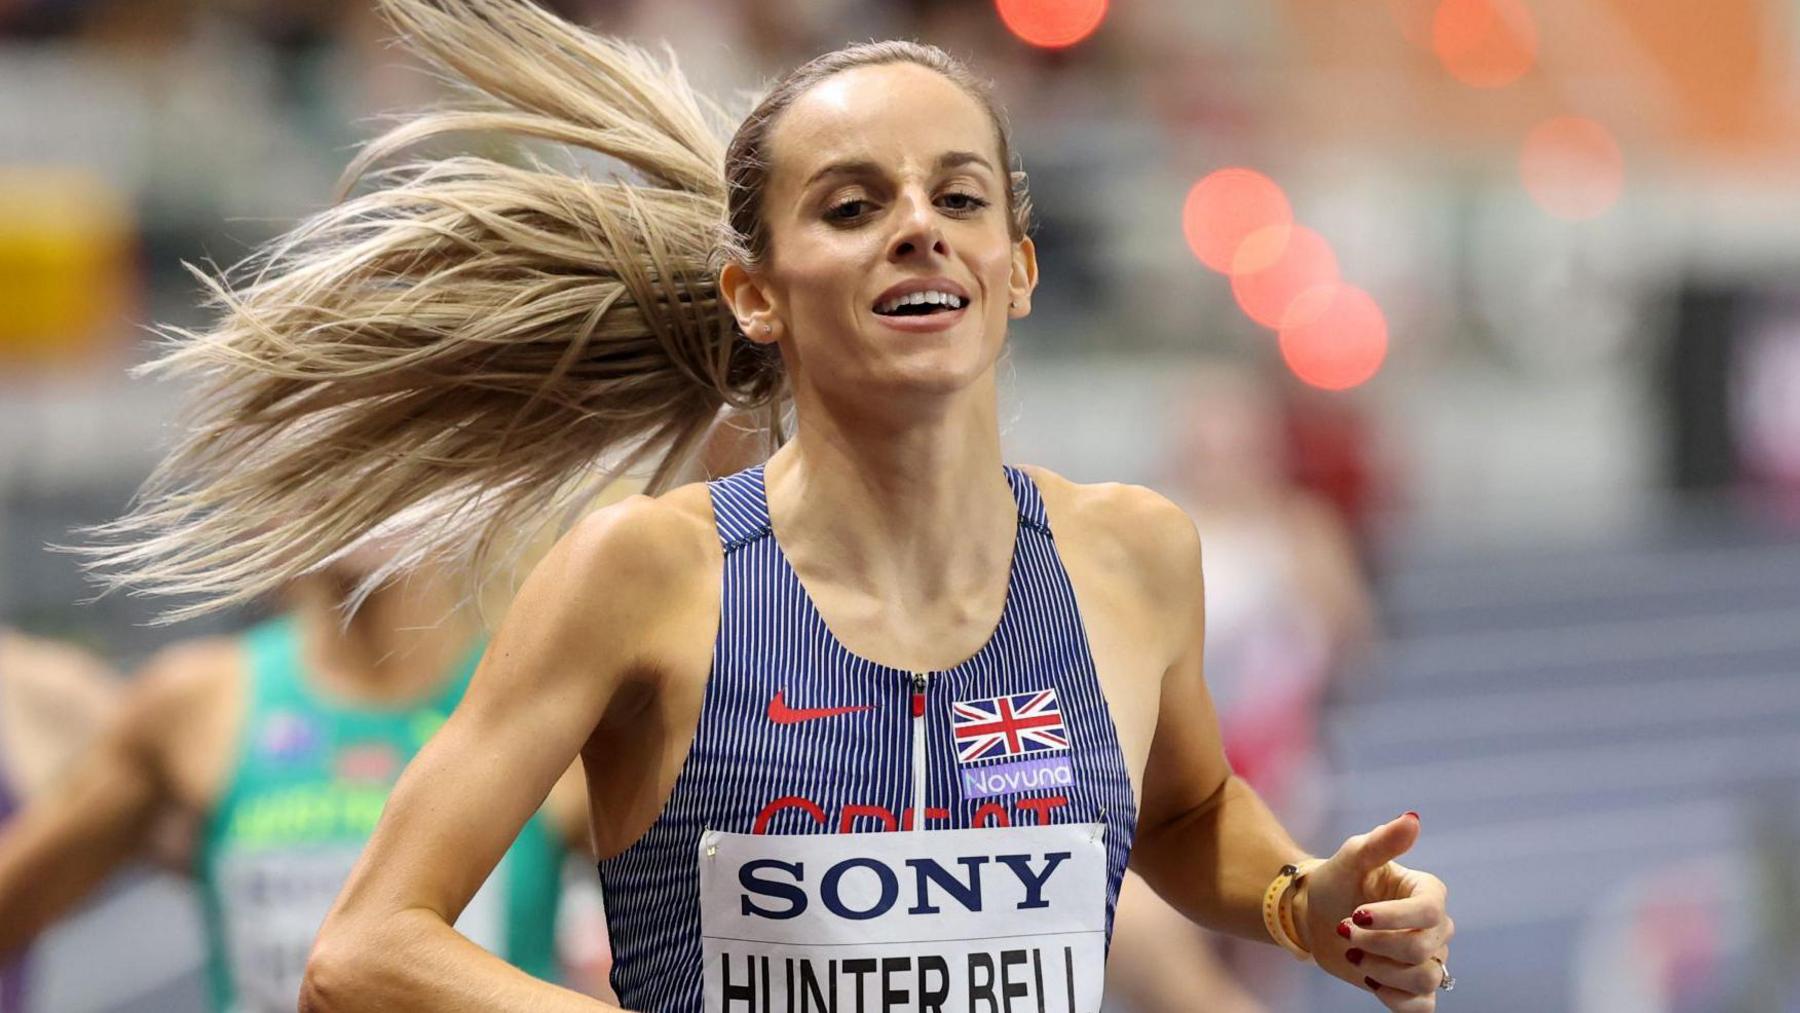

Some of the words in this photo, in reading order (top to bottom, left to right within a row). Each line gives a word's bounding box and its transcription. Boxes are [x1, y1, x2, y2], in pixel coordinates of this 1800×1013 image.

[965, 765, 1072, 797] Novuna
[738, 852, 1071, 920] SONY
[721, 952, 951, 1013] HUNTER
